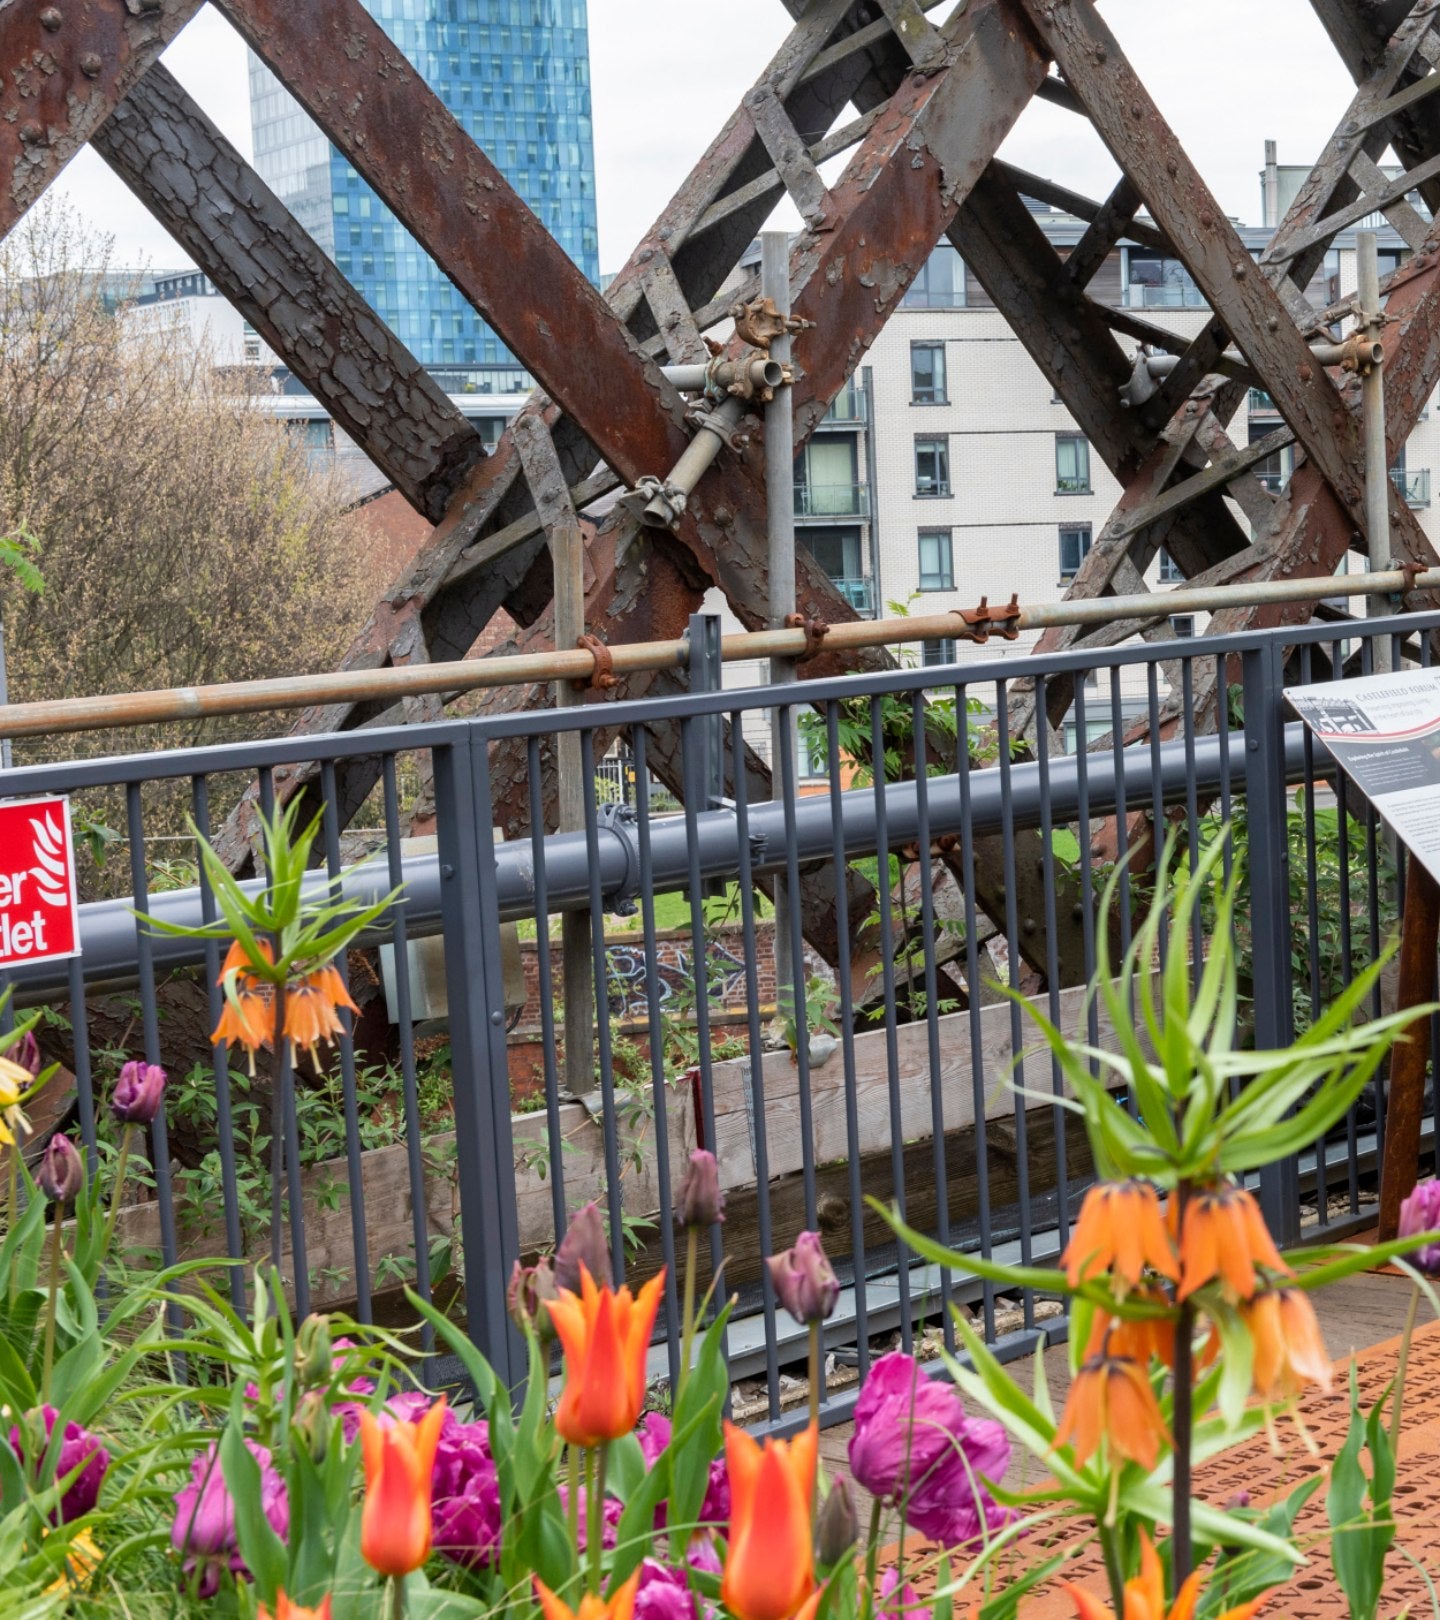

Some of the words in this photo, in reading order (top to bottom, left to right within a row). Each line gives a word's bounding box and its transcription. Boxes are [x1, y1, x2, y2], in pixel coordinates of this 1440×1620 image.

[1353, 687, 1410, 701] CASTLEFIELD
[1406, 683, 1438, 693] FORUM
[1291, 1394, 1350, 1414] RED
[1315, 1410, 1357, 1422] IS
